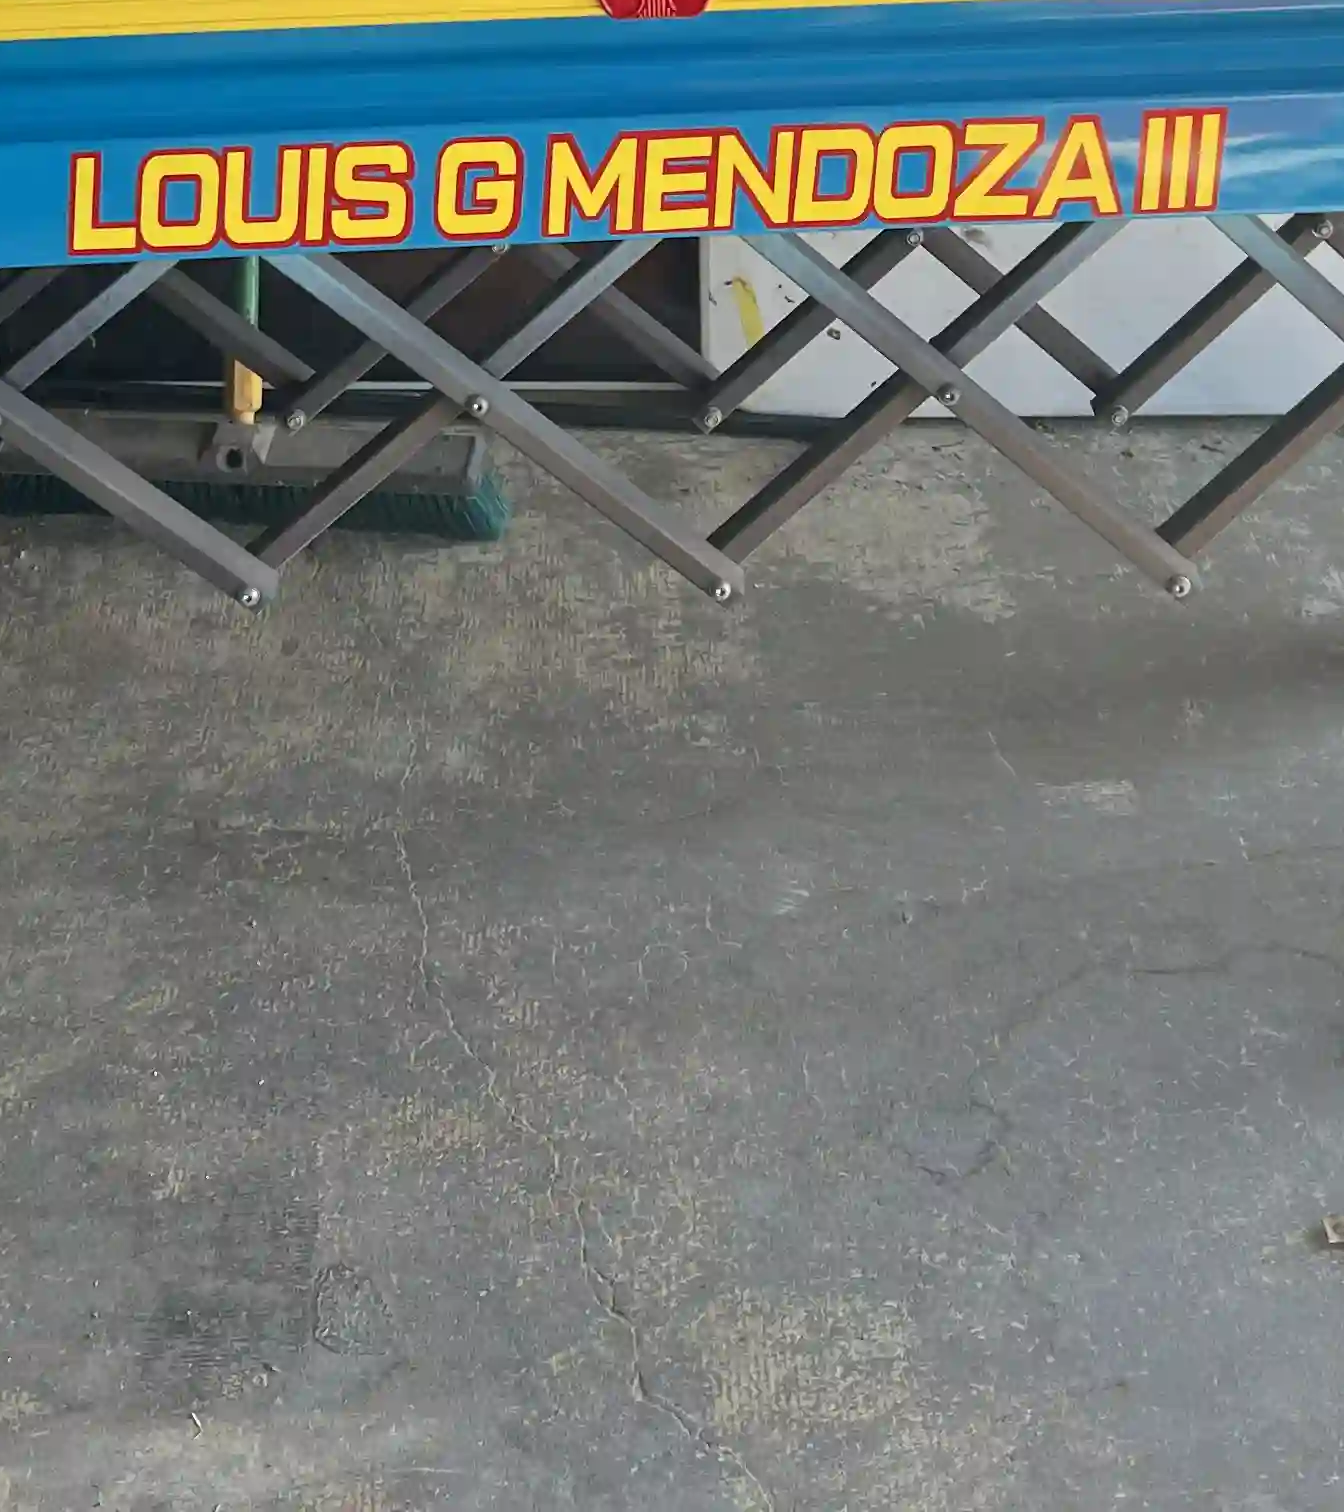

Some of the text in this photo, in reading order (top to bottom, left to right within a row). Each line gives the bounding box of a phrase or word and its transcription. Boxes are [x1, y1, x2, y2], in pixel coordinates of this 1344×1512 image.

[68, 108, 1228, 256] LOUIS G MENDOZA III
